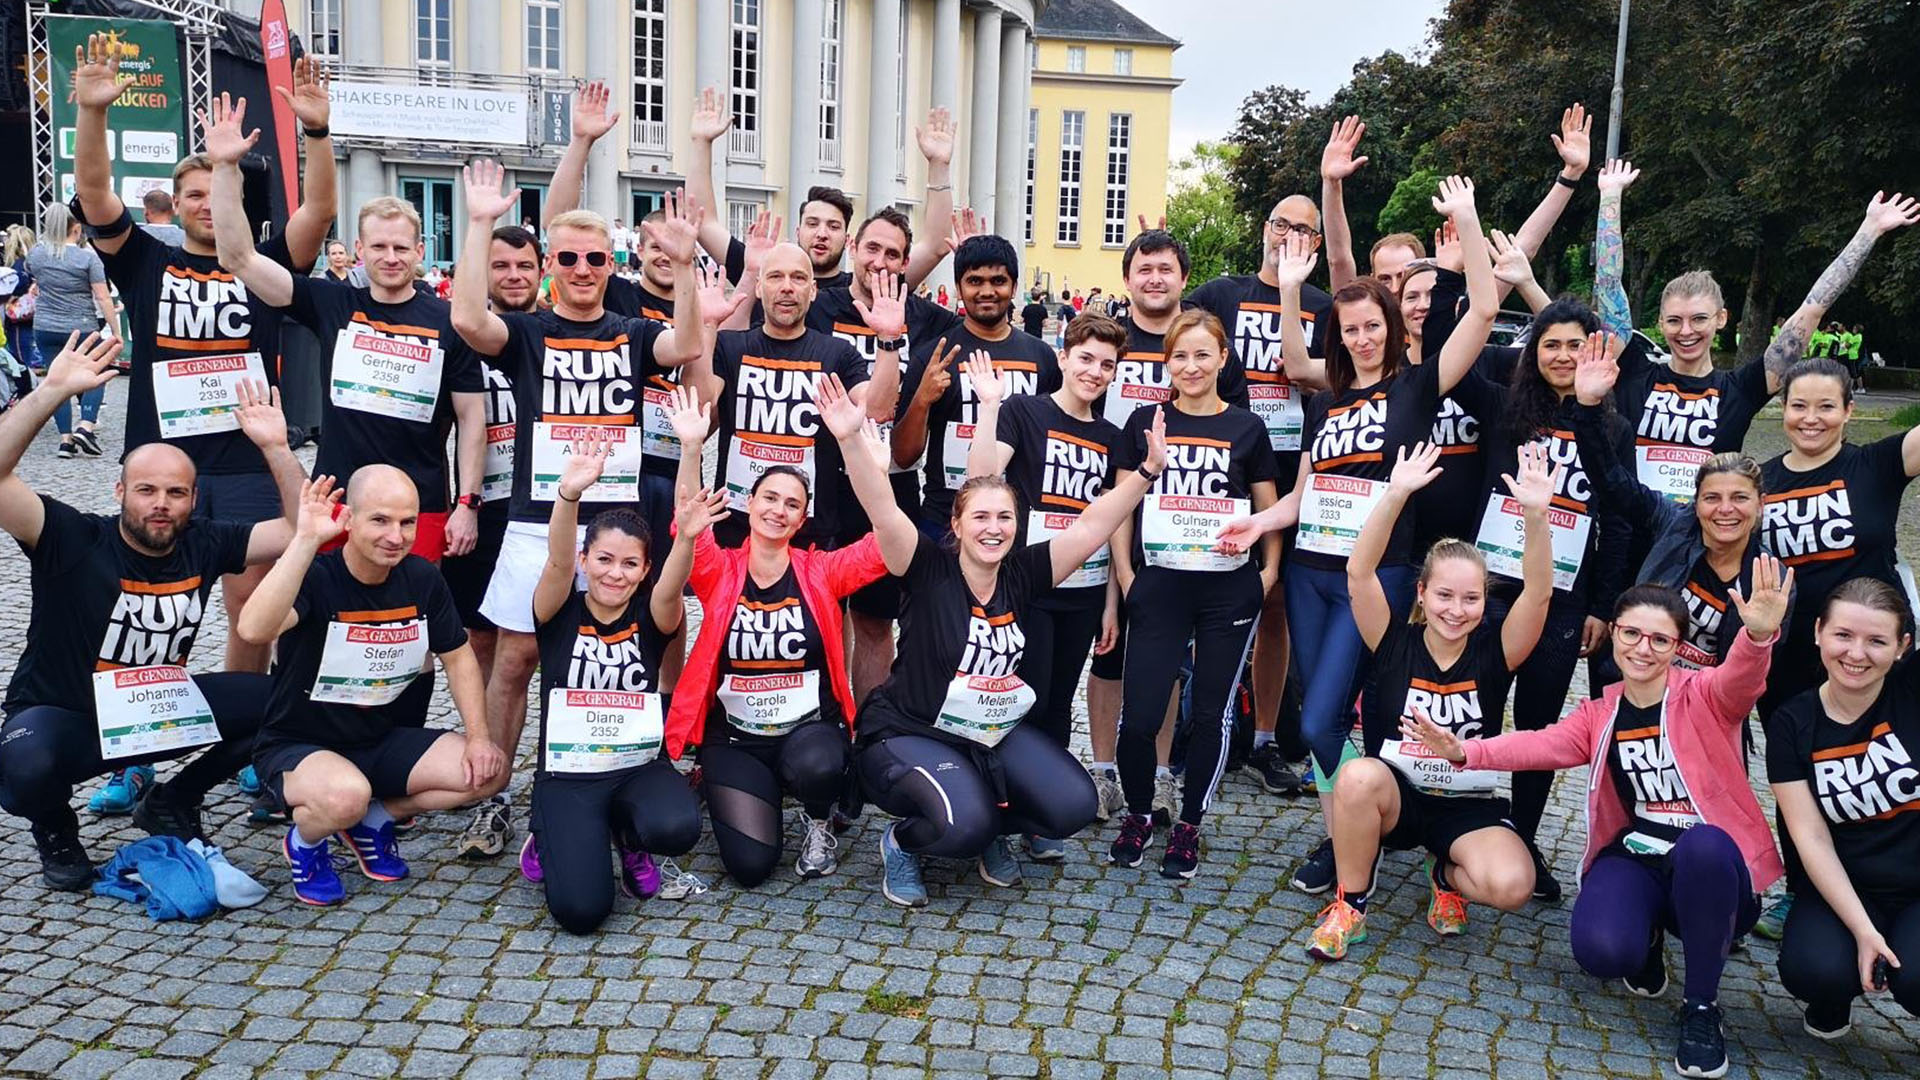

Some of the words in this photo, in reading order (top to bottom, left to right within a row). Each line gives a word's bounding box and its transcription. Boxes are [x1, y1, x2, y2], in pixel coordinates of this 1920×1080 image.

[119, 60, 151, 71] energis
[328, 90, 447, 109] SHAKESPEARE
[452, 97, 468, 110] IN
[474, 98, 517, 113] LOVE
[552, 93, 562, 142] Morgen
[124, 142, 171, 158] energis
[161, 272, 248, 307] RUN
[157, 302, 252, 339] IMC
[372, 341, 429, 360] GENERALI
[543, 344, 632, 380] RUN
[187, 358, 245, 373] GENERALI
[362, 353, 416, 374] Gerhard
[200, 376, 222, 388] Kai
[372, 370, 400, 383] 2358
[736, 364, 822, 400] RUN
[200, 389, 228, 401] 2339
[542, 378, 635, 414] IMC
[1248, 386, 1290, 398] ENERALI
[1644, 390, 1720, 420] RUN
[735, 397, 820, 437] IMC
[1318, 400, 1387, 436] RUN
[1637, 409, 1717, 446] IMC
[753, 446, 803, 462] GENERALI
[1312, 425, 1385, 462] IMC
[1046, 438, 1108, 479] RUN
[1166, 445, 1231, 472] RUN
[1042, 464, 1103, 504] IMC
[1154, 470, 1229, 498] IMC
[1178, 500, 1234, 513] GENERALI
[1320, 509, 1341, 521] 2333
[1762, 489, 1852, 530] RUN
[1172, 513, 1221, 527] Gulnara
[1183, 528, 1209, 538] 2354
[1762, 518, 1856, 558] IMC
[110, 587, 202, 631] RUN
[731, 604, 805, 633] RUN
[99, 622, 196, 665] IMC
[369, 626, 419, 642] GENERALI
[728, 631, 807, 660] IMC
[967, 616, 1026, 654] RUN
[364, 646, 404, 659] Stefan
[572, 633, 641, 666] RUN
[958, 643, 1023, 677] IMC
[139, 667, 188, 683] GENERALI
[368, 661, 396, 672] 2355
[567, 658, 649, 692] IMC
[746, 675, 803, 690] GENERALI
[127, 686, 190, 704] Johannes
[586, 692, 643, 708] GENERALI
[745, 694, 787, 707] Carola
[977, 694, 1018, 706] Melanie
[1403, 687, 1483, 725] RUN
[150, 701, 178, 714] 2336
[586, 710, 624, 724] Diana
[754, 707, 780, 718] 2347
[984, 707, 1009, 718] 2328
[590, 726, 619, 737] 2352
[1618, 735, 1675, 771] RU
[1814, 733, 1912, 796] RUN
[1423, 773, 1452, 784] 2340
[1820, 767, 1920, 824] IMC
